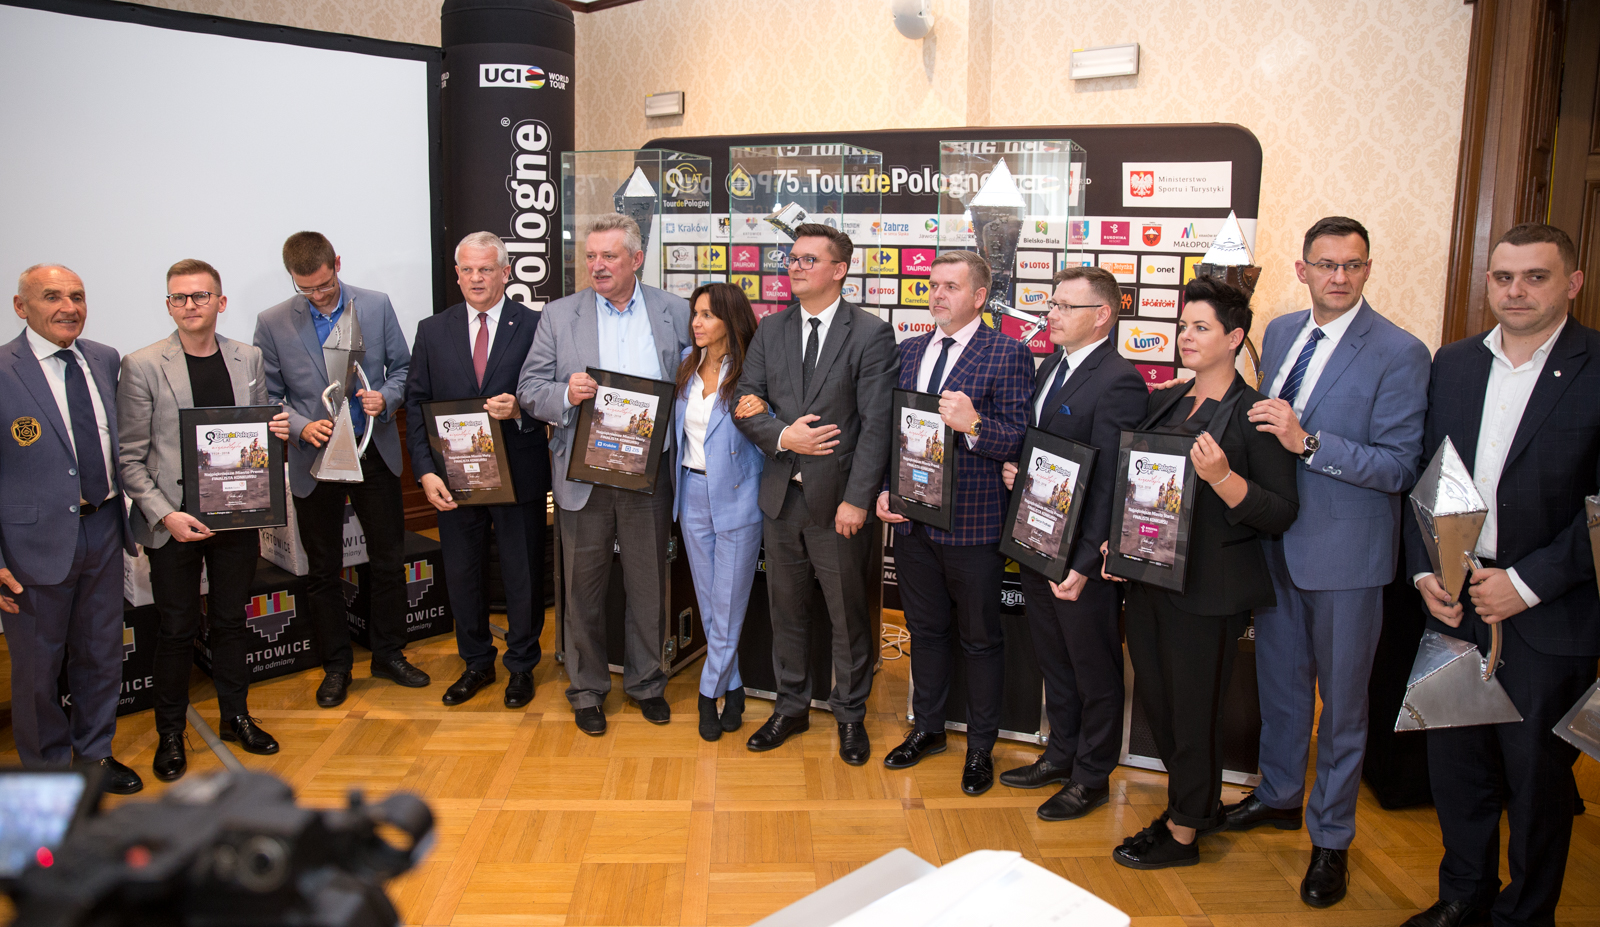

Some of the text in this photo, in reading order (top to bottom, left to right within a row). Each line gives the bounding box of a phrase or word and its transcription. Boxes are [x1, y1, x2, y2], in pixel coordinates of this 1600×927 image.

[485, 68, 521, 83] UCI
[548, 72, 570, 84] WORLD
[549, 80, 566, 90] TOUR
[685, 173, 702, 183] LAT
[663, 200, 710, 209] TourdePologne
[678, 223, 709, 232] Kraków
[884, 222, 909, 232] Zabrze
[1029, 262, 1050, 270] LOTOS
[1156, 266, 1175, 274] onet
[1025, 293, 1043, 303] LOTTO
[1134, 336, 1160, 349] LOTTO
[262, 531, 291, 553] KATOWICE
[406, 606, 445, 623] OWICE
[407, 622, 432, 633] odmiany
[245, 639, 311, 665] ATOWICE
[253, 657, 296, 673] dla odmiany
